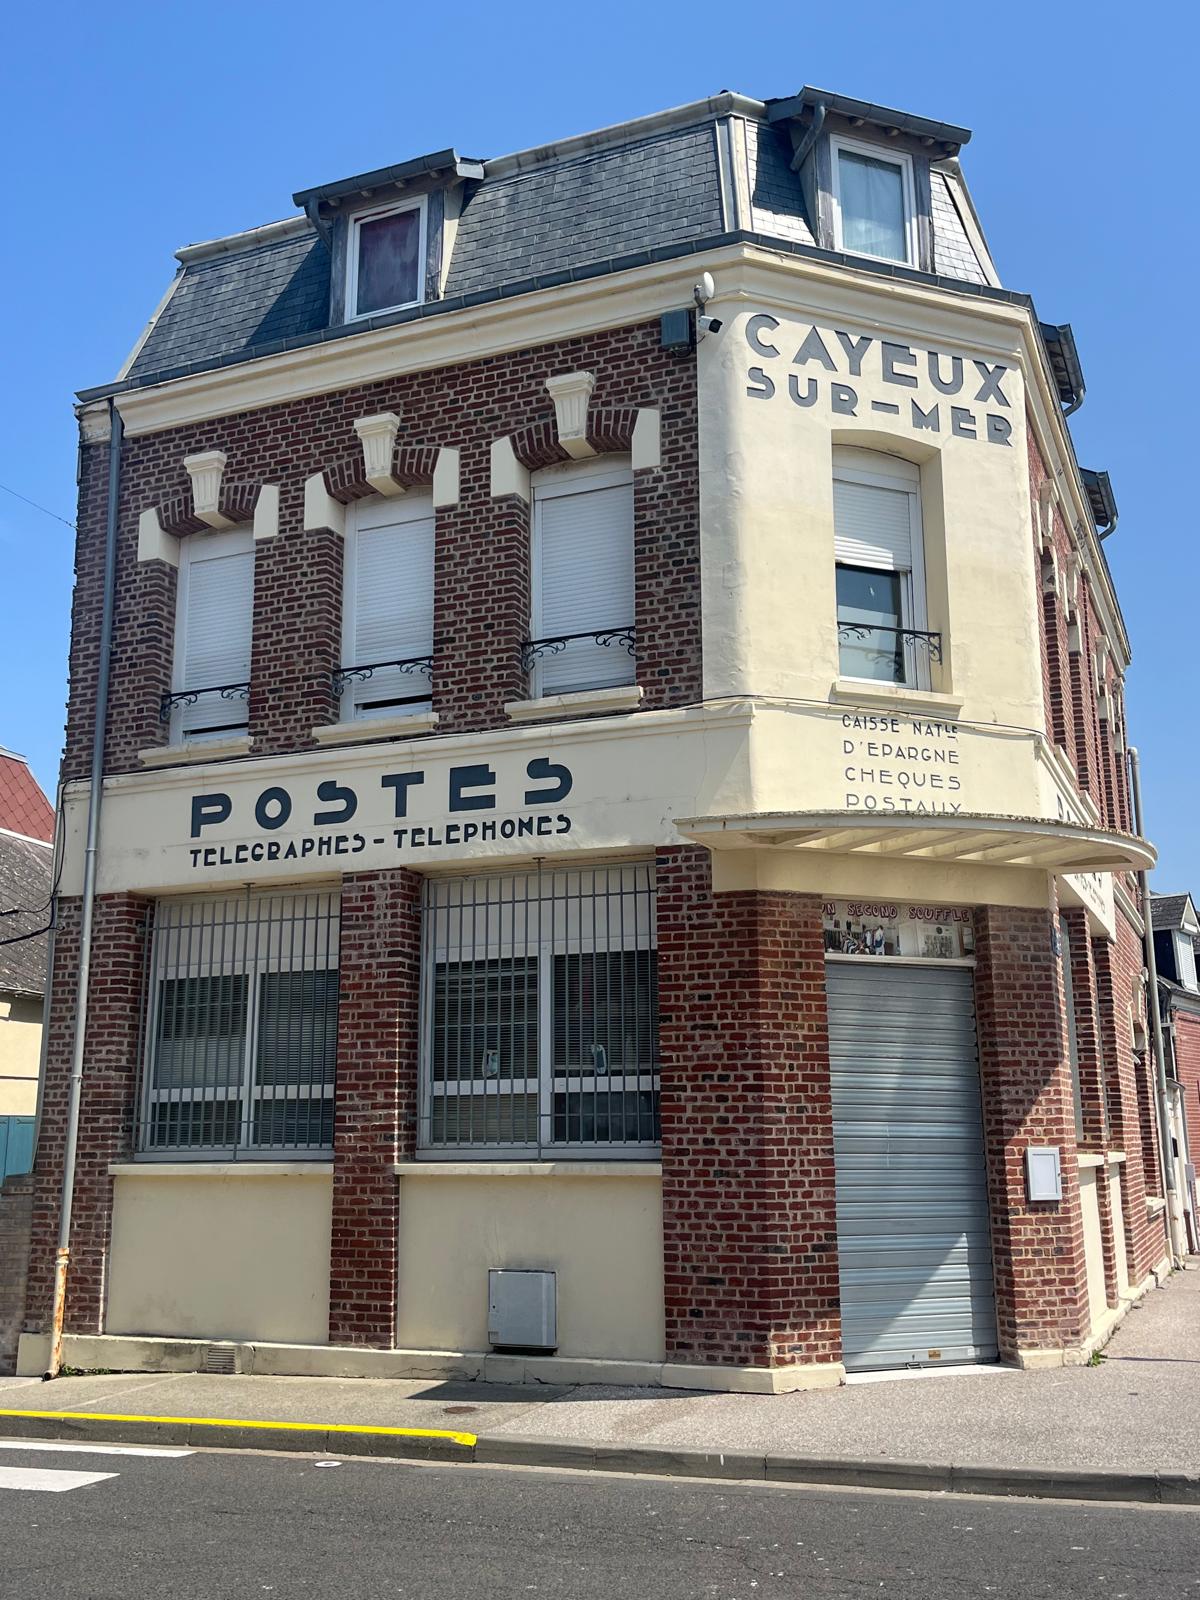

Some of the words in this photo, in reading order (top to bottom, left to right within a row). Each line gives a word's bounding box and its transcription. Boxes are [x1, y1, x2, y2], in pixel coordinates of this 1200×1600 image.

[745, 313, 1011, 408] CAYEUX
[746, 366, 1013, 447] SUR-MER
[842, 714, 900, 733] CAISSE
[843, 740, 960, 764] D'EPARGNE
[845, 767, 961, 790] CHEQUES
[190, 757, 573, 838] POSTES
[846, 793, 962, 814] POSTAUX
[848, 903, 897, 919] SECOND
[909, 907, 970, 922] SOUFFLE
